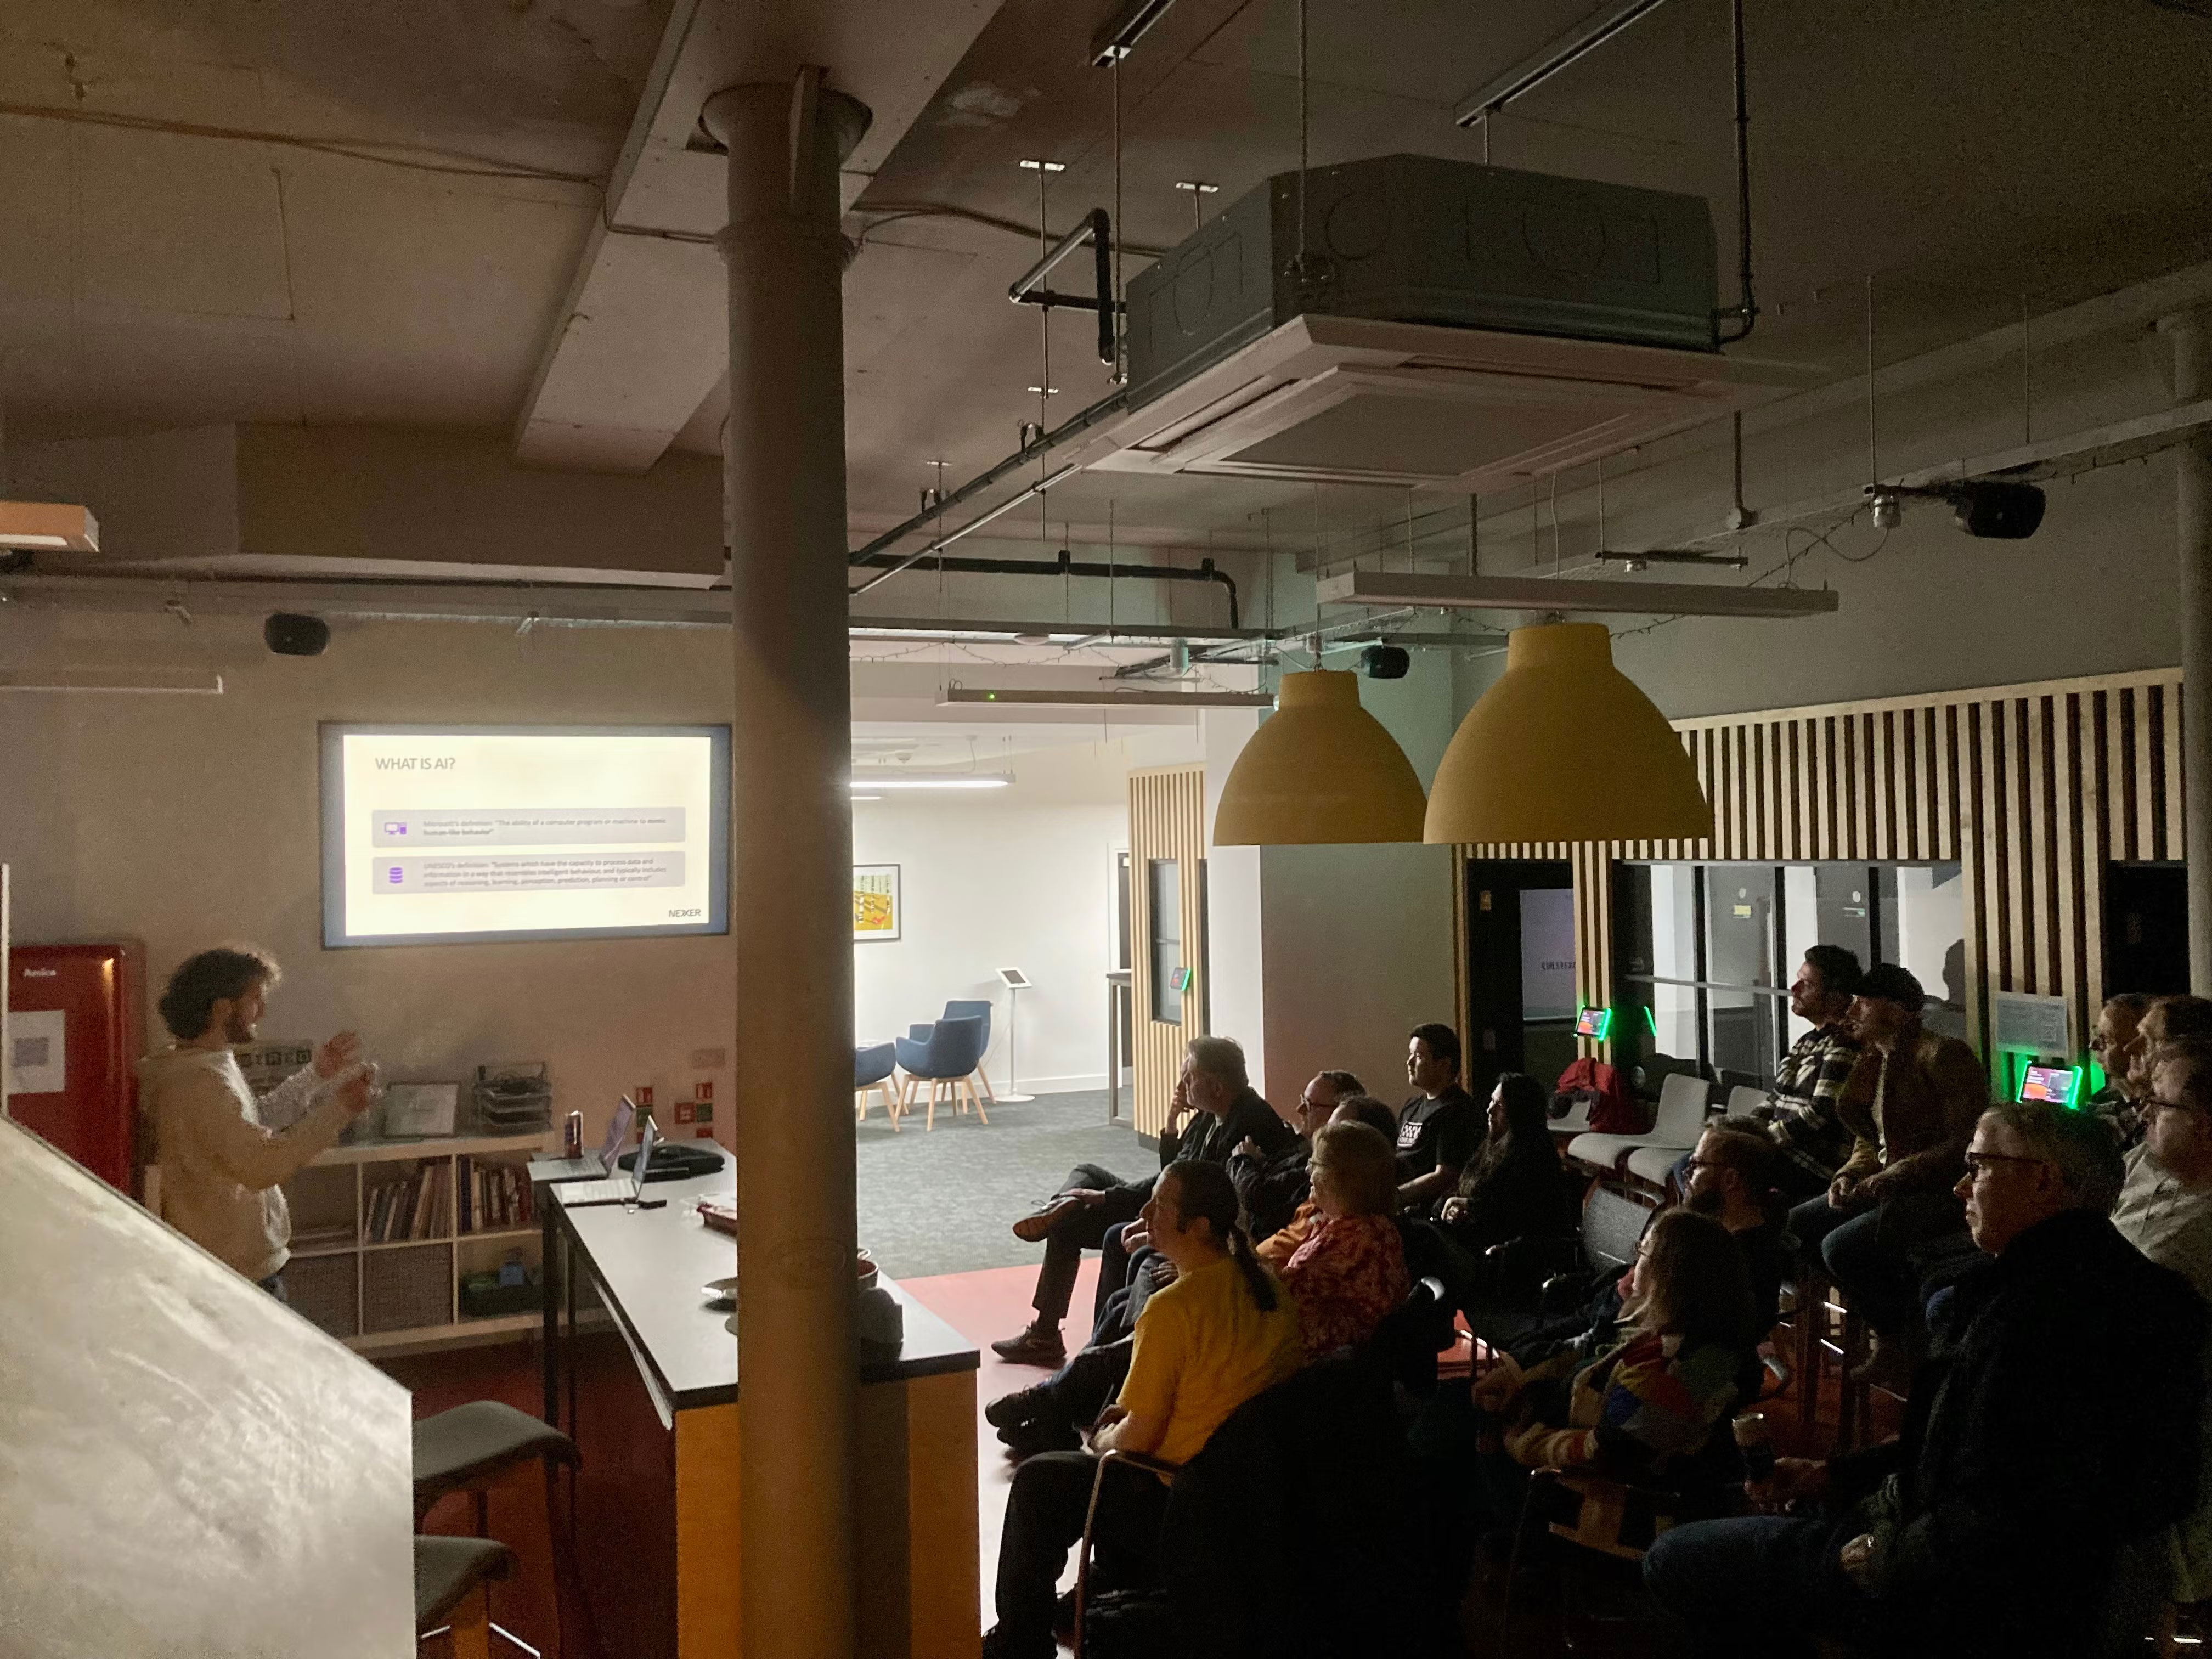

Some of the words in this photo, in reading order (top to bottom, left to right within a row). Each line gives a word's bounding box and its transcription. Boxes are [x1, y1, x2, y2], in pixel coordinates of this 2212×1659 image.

[375, 758, 417, 769] WHAT
[420, 758, 432, 769] IS
[434, 757, 456, 769] AI?
